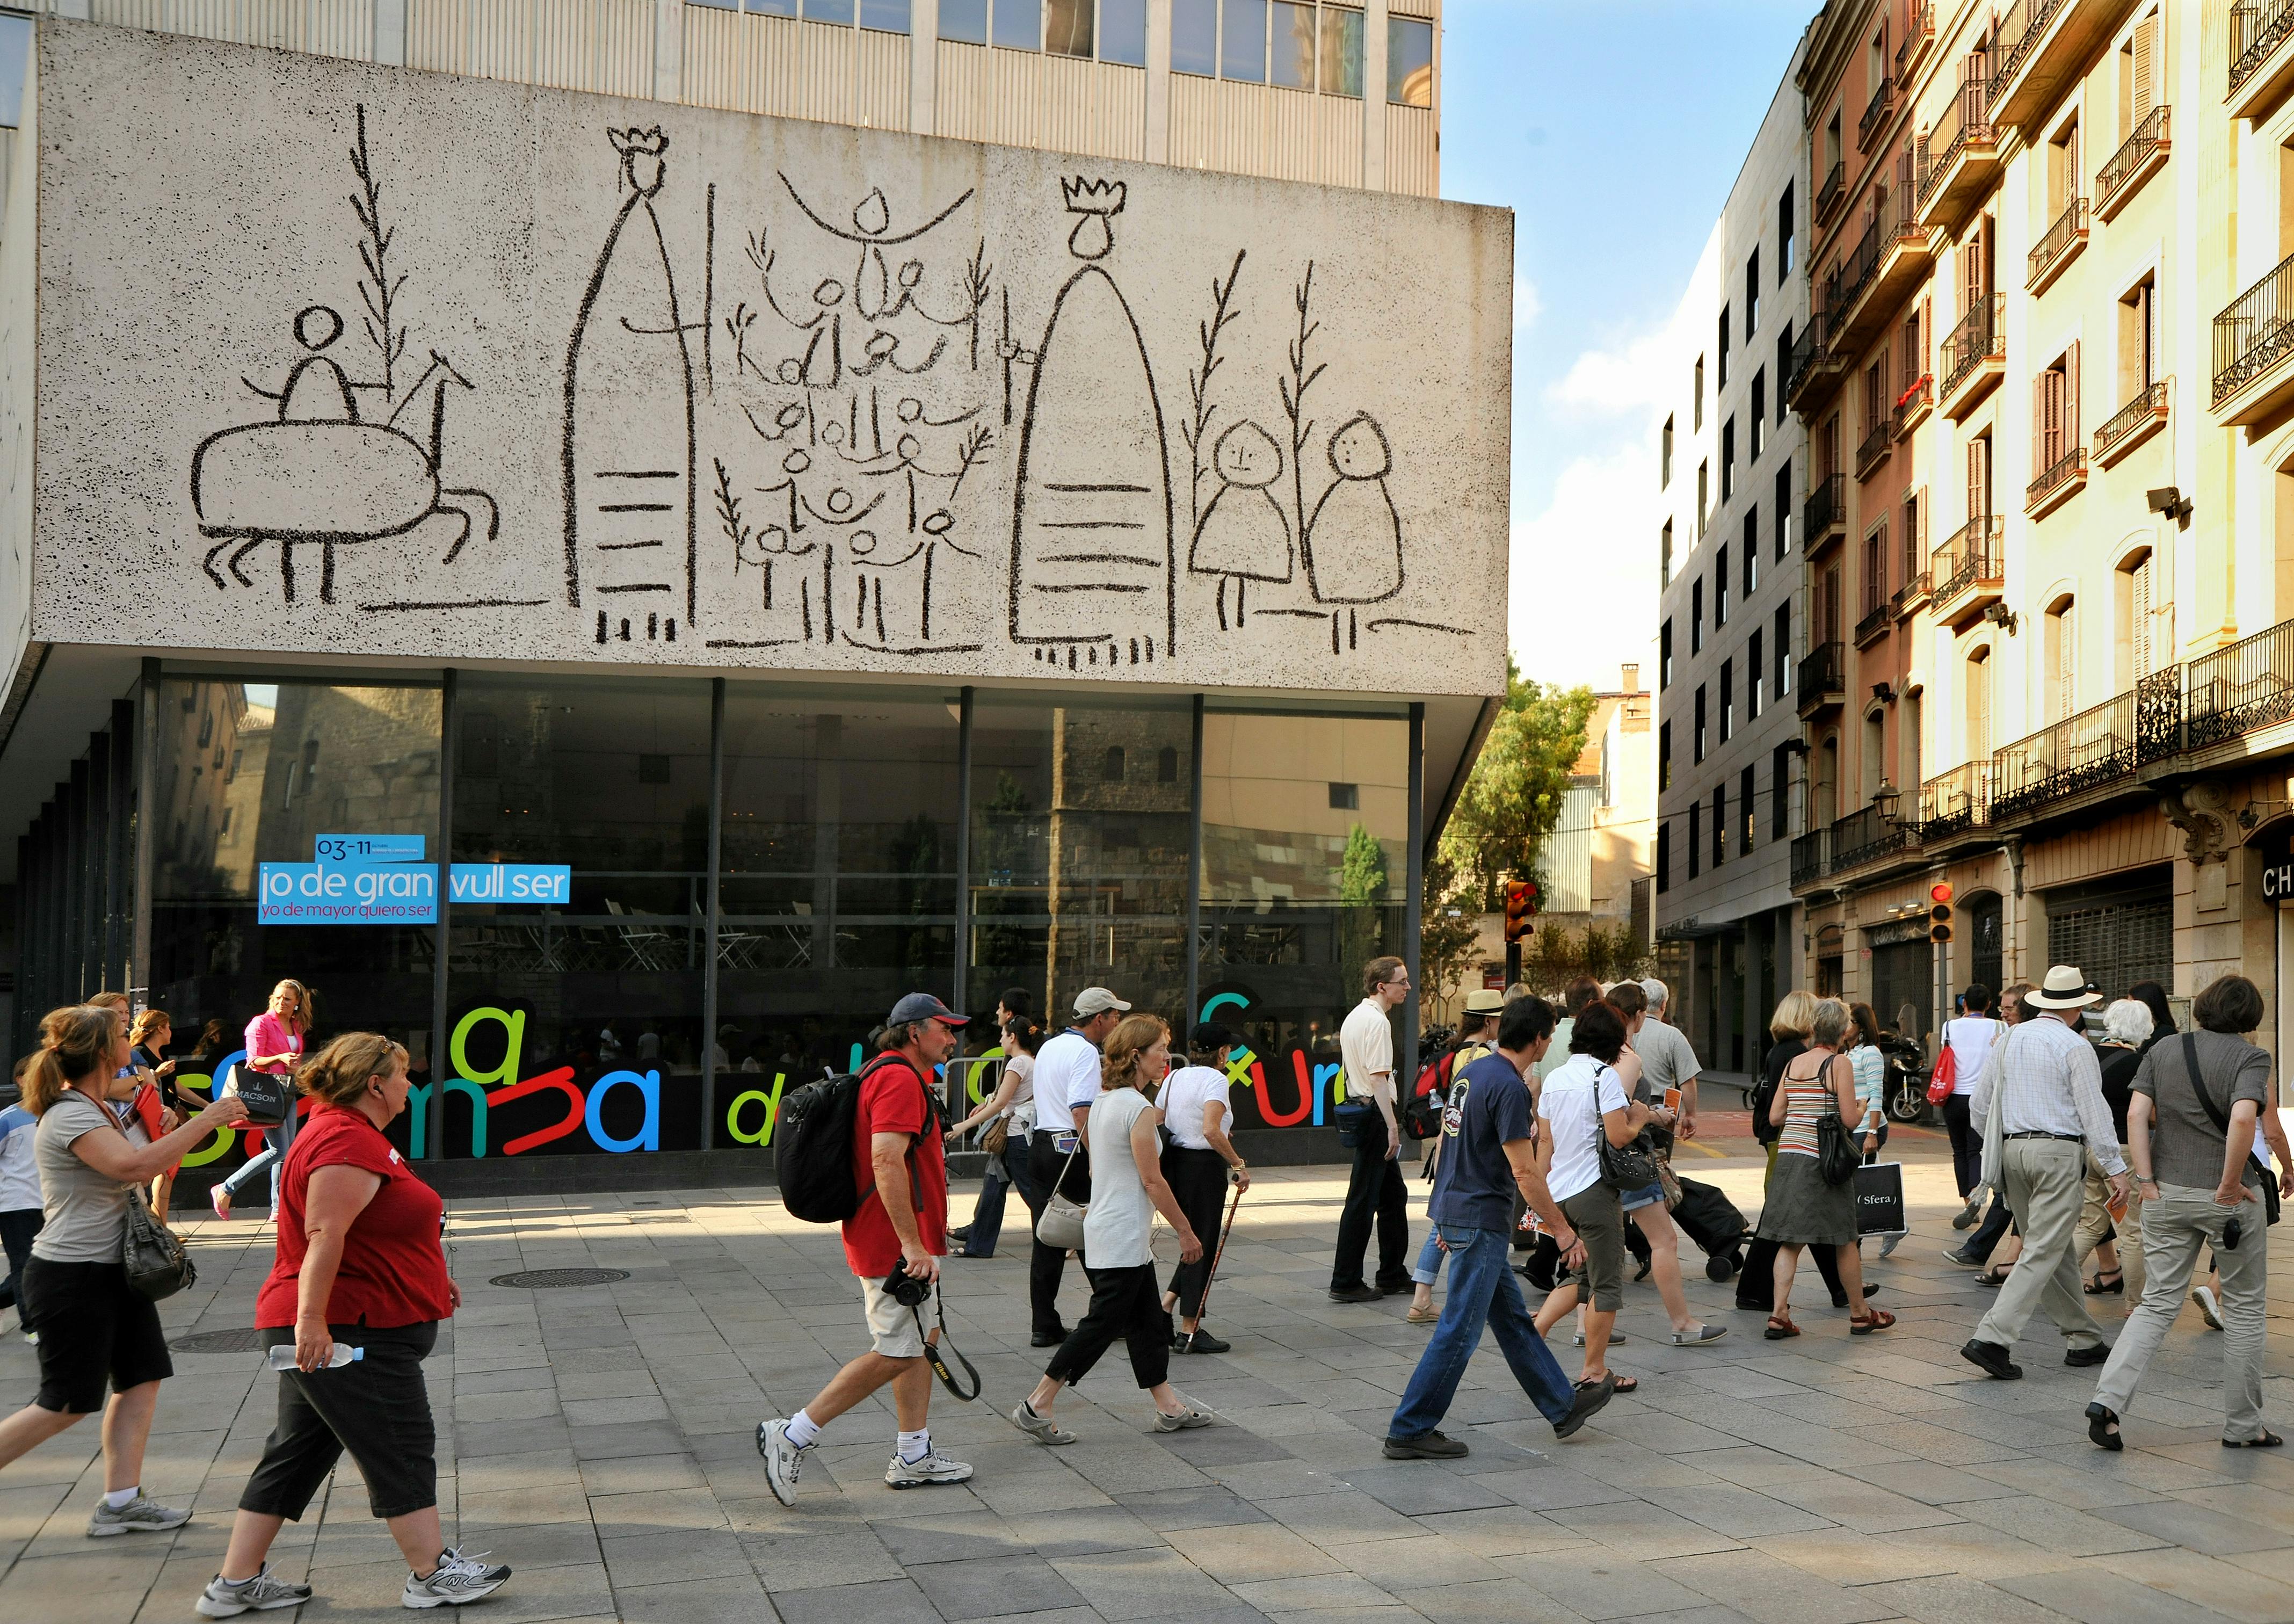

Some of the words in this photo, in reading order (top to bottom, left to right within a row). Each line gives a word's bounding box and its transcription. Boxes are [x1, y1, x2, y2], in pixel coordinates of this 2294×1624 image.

[262, 866, 293, 904] jo
[300, 864, 347, 897] de
[354, 873, 433, 905] gran
[450, 865, 504, 897] vull
[511, 874, 565, 897] ser
[262, 905, 280, 919] yo
[283, 902, 303, 916] de
[307, 905, 357, 919] mayor
[359, 903, 406, 919] quiero
[409, 905, 432, 916] ser
[236, 1091, 277, 1103] MACSON
[934, 1361, 949, 1380] Nikon
